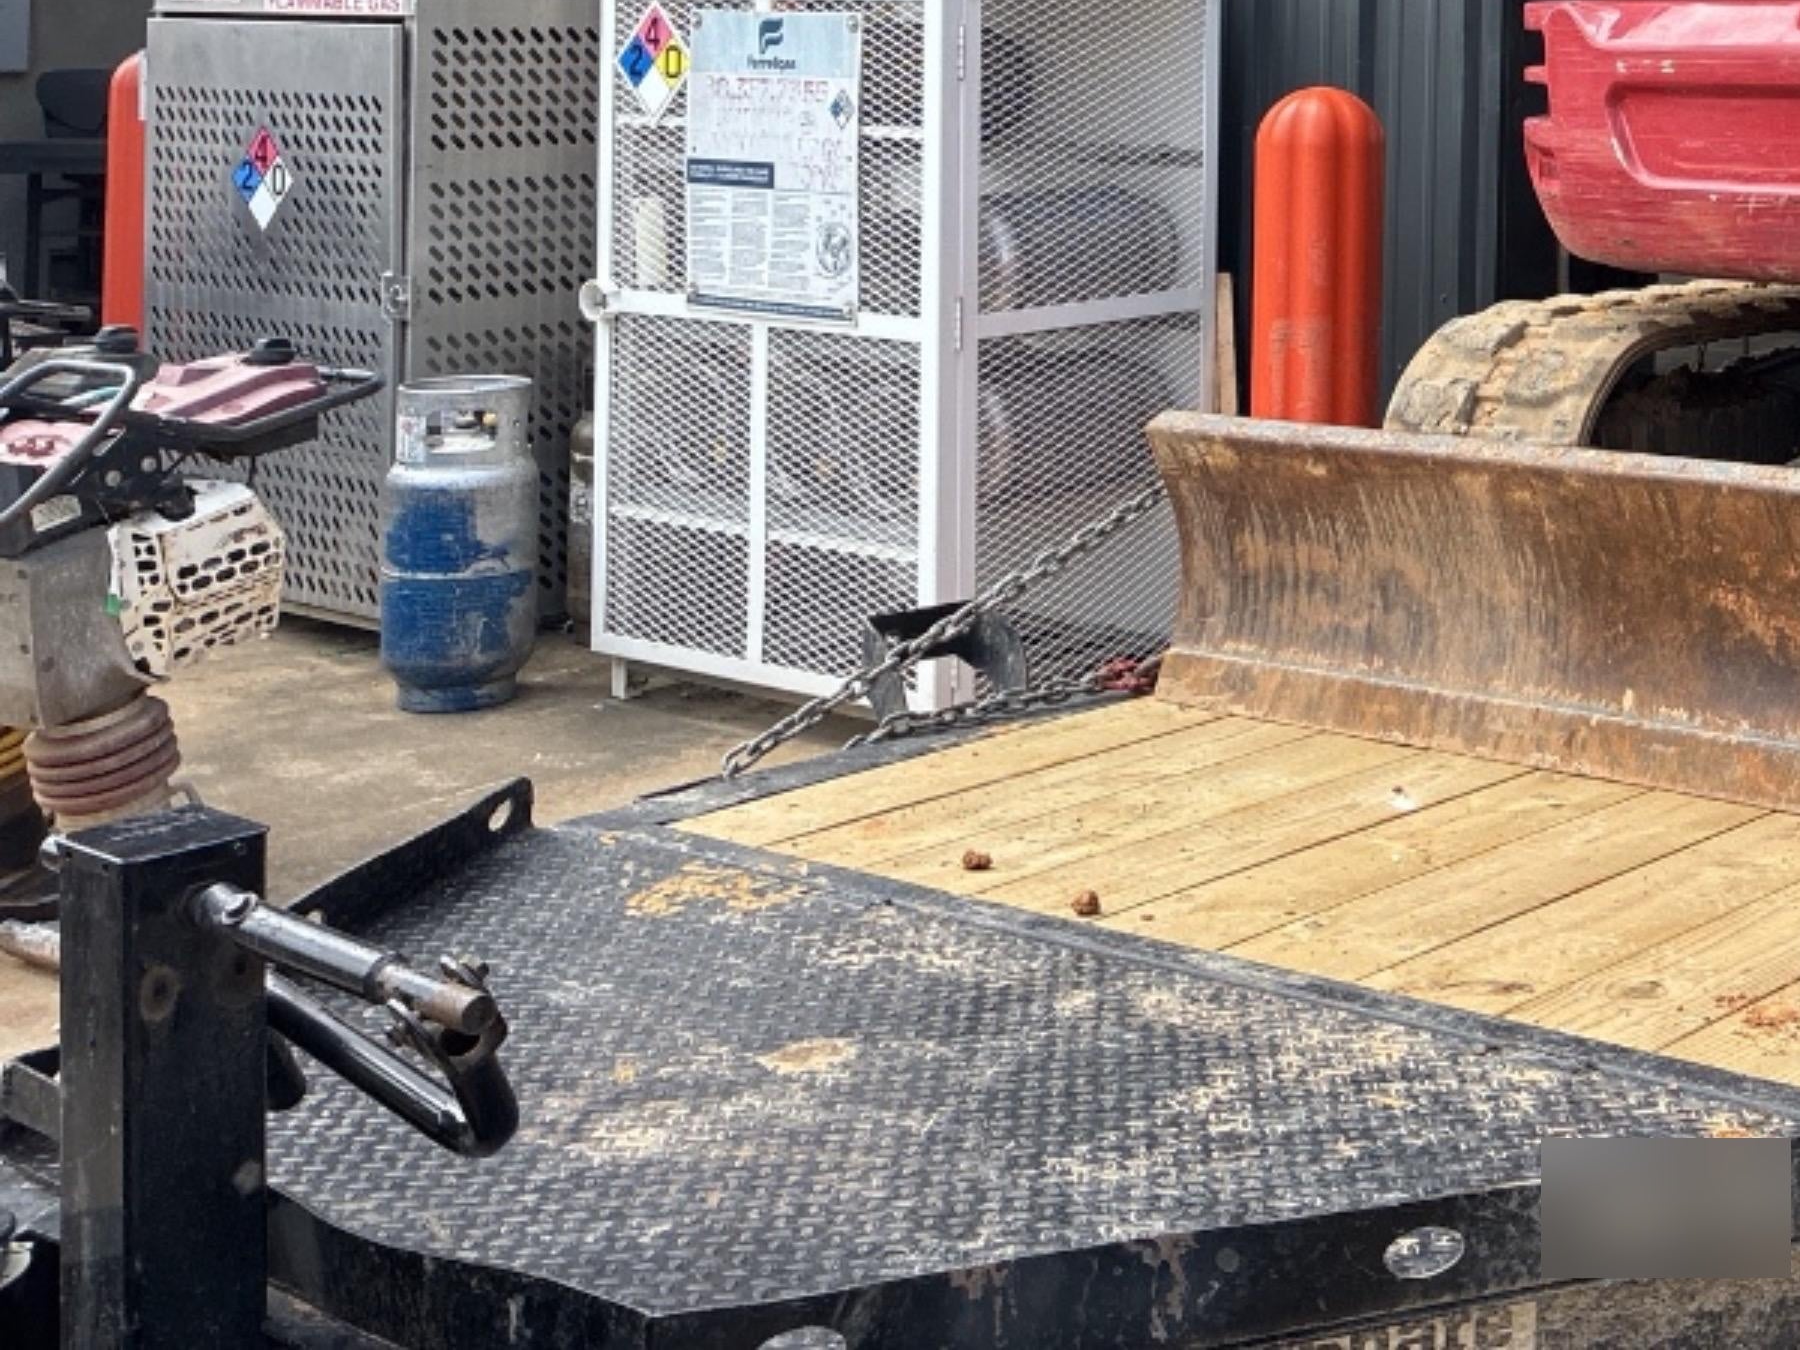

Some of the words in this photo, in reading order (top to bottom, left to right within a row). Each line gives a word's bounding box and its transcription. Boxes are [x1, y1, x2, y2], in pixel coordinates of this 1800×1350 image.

[645, 18, 660, 51] 4
[629, 44, 643, 76] 2
[255, 135, 267, 169] 4
[242, 161, 254, 189] 2
